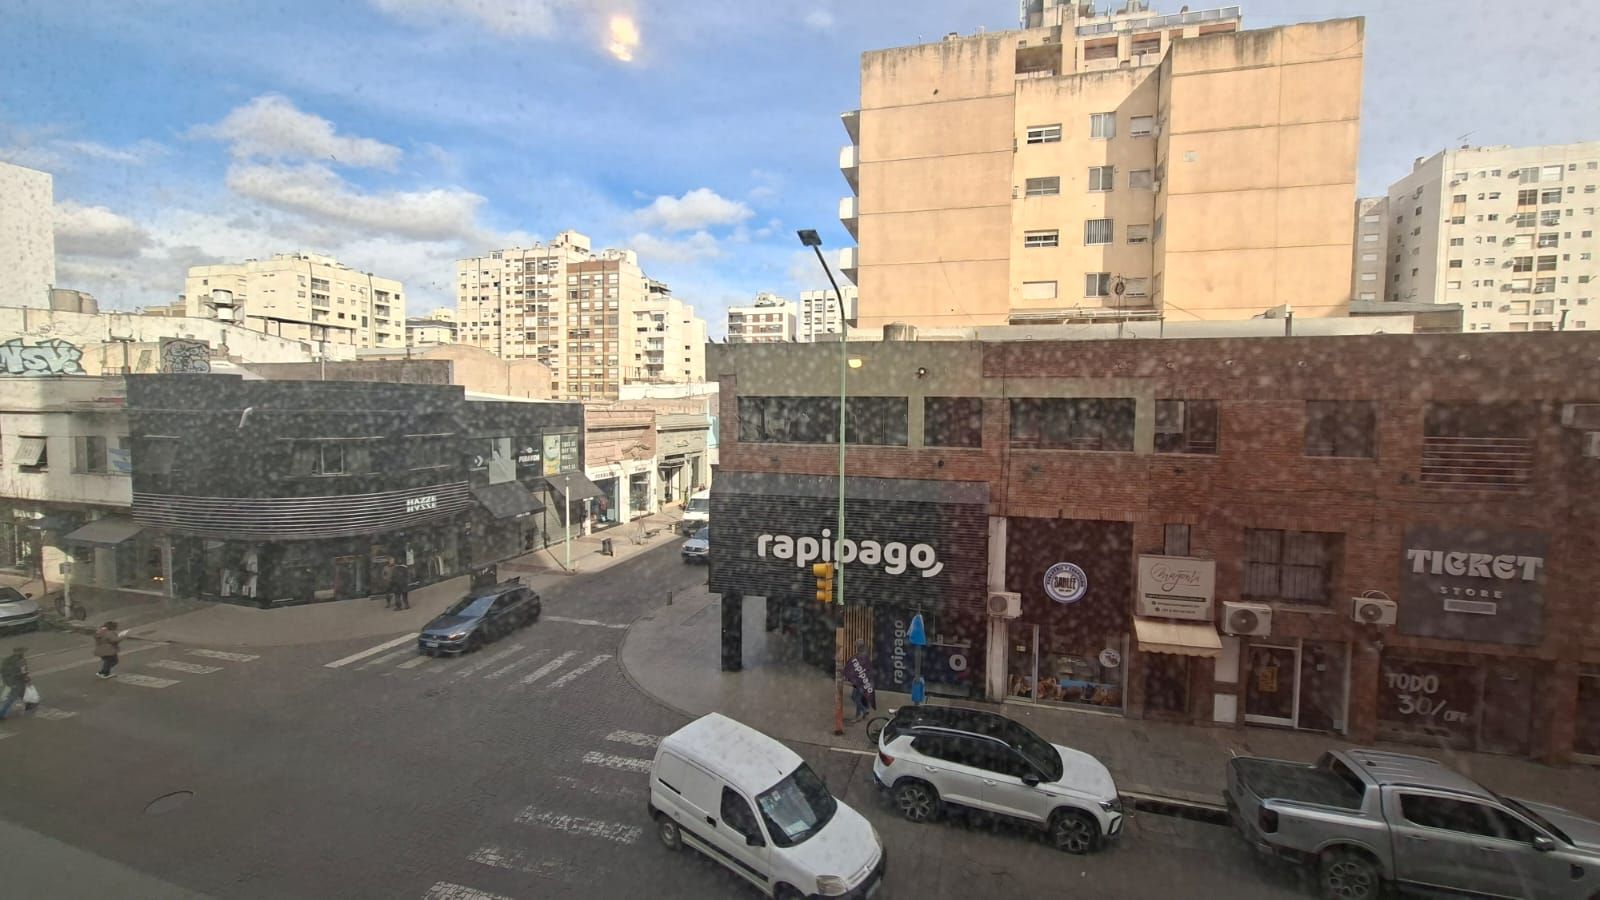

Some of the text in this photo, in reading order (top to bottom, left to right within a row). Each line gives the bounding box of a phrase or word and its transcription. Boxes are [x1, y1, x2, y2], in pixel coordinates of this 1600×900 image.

[757, 528, 944, 577] rapipago
[1440, 586, 1503, 599] STORE
[891, 620, 906, 684] rapipago
[851, 658, 874, 694] rapipago
[1386, 673, 1439, 694] TODO
